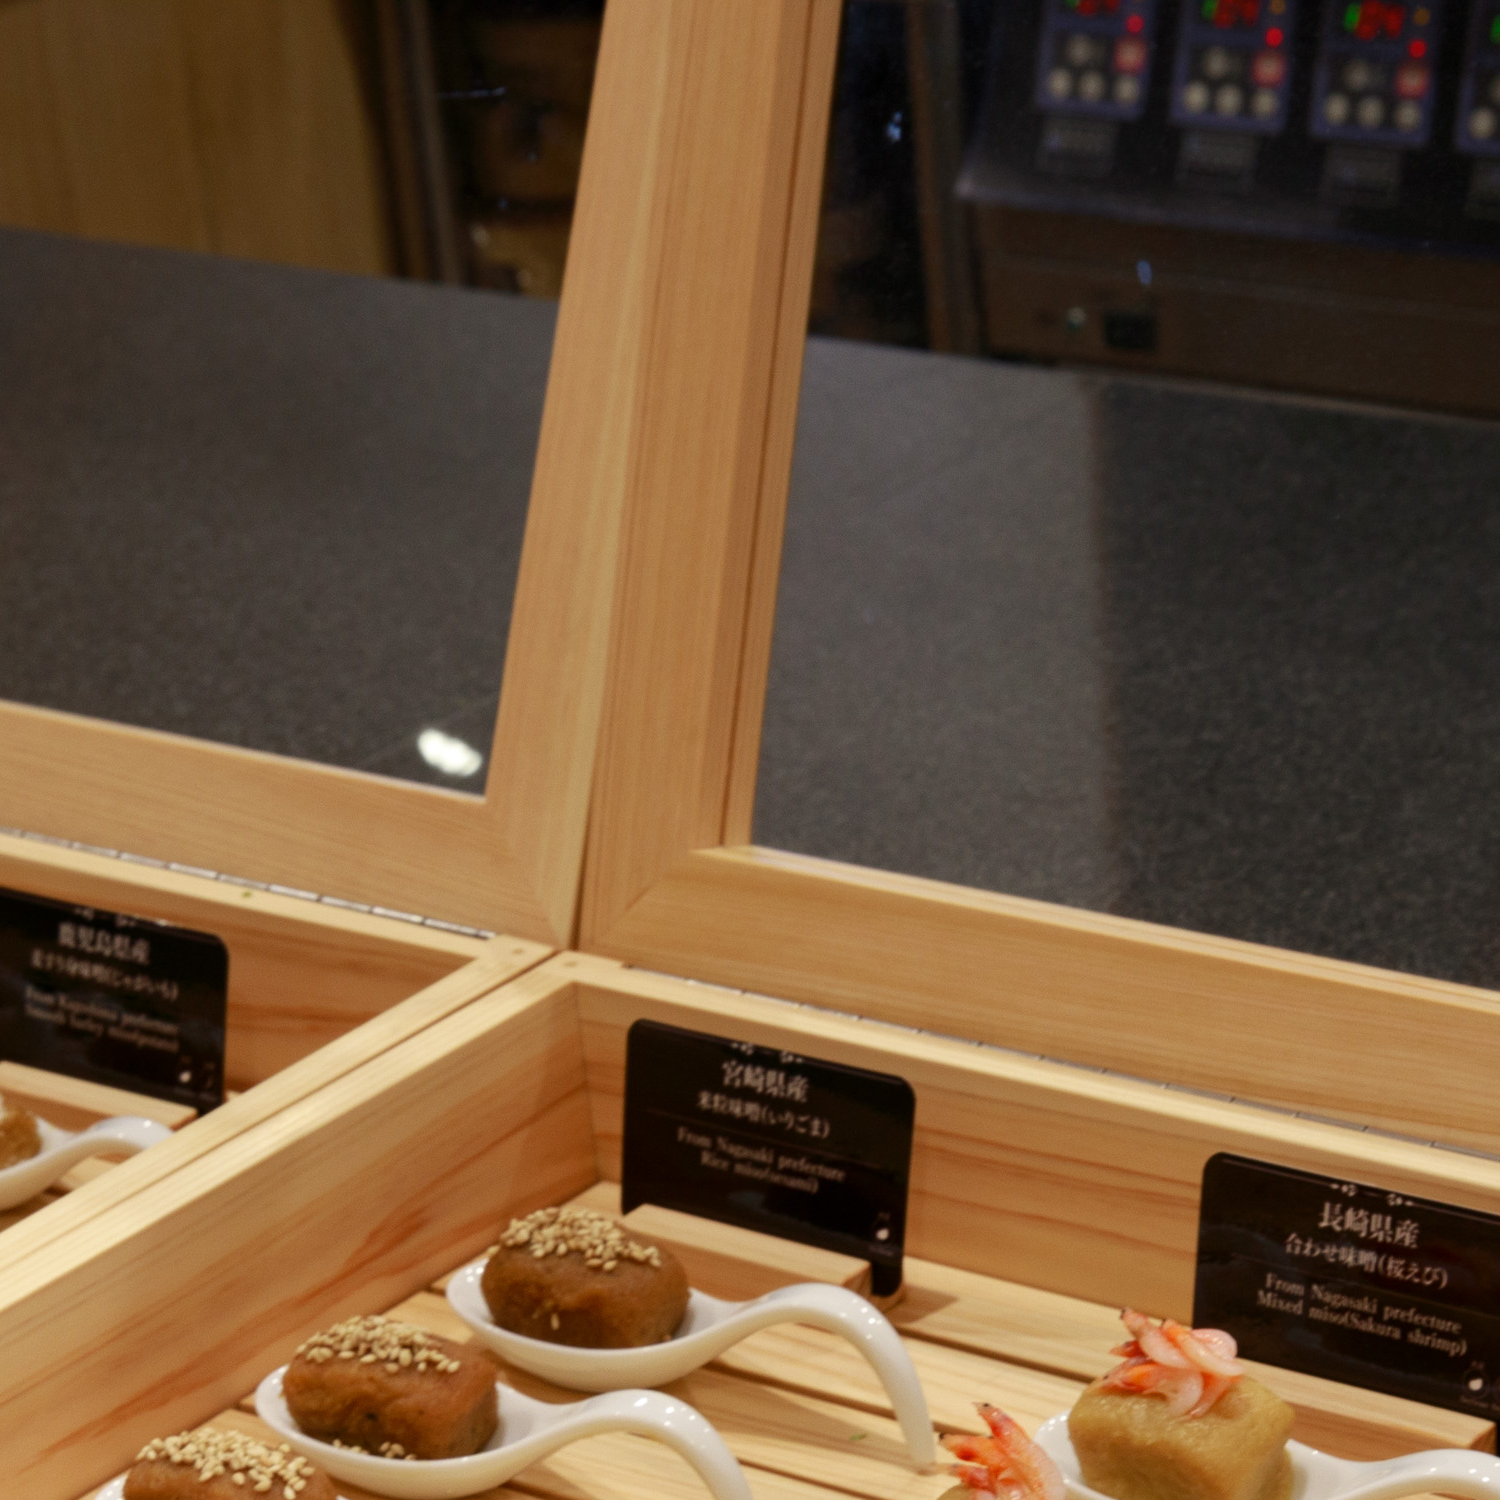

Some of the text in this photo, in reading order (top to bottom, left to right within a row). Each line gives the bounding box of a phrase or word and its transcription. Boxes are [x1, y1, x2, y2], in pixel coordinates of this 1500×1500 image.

[1318, 1202, 1420, 1249] 長崎県産
[1257, 1291, 1303, 1316] Mixed
[1407, 1327, 1467, 1357] shrimp)
[1265, 1273, 1463, 1334] From Nagasaki prefecture
